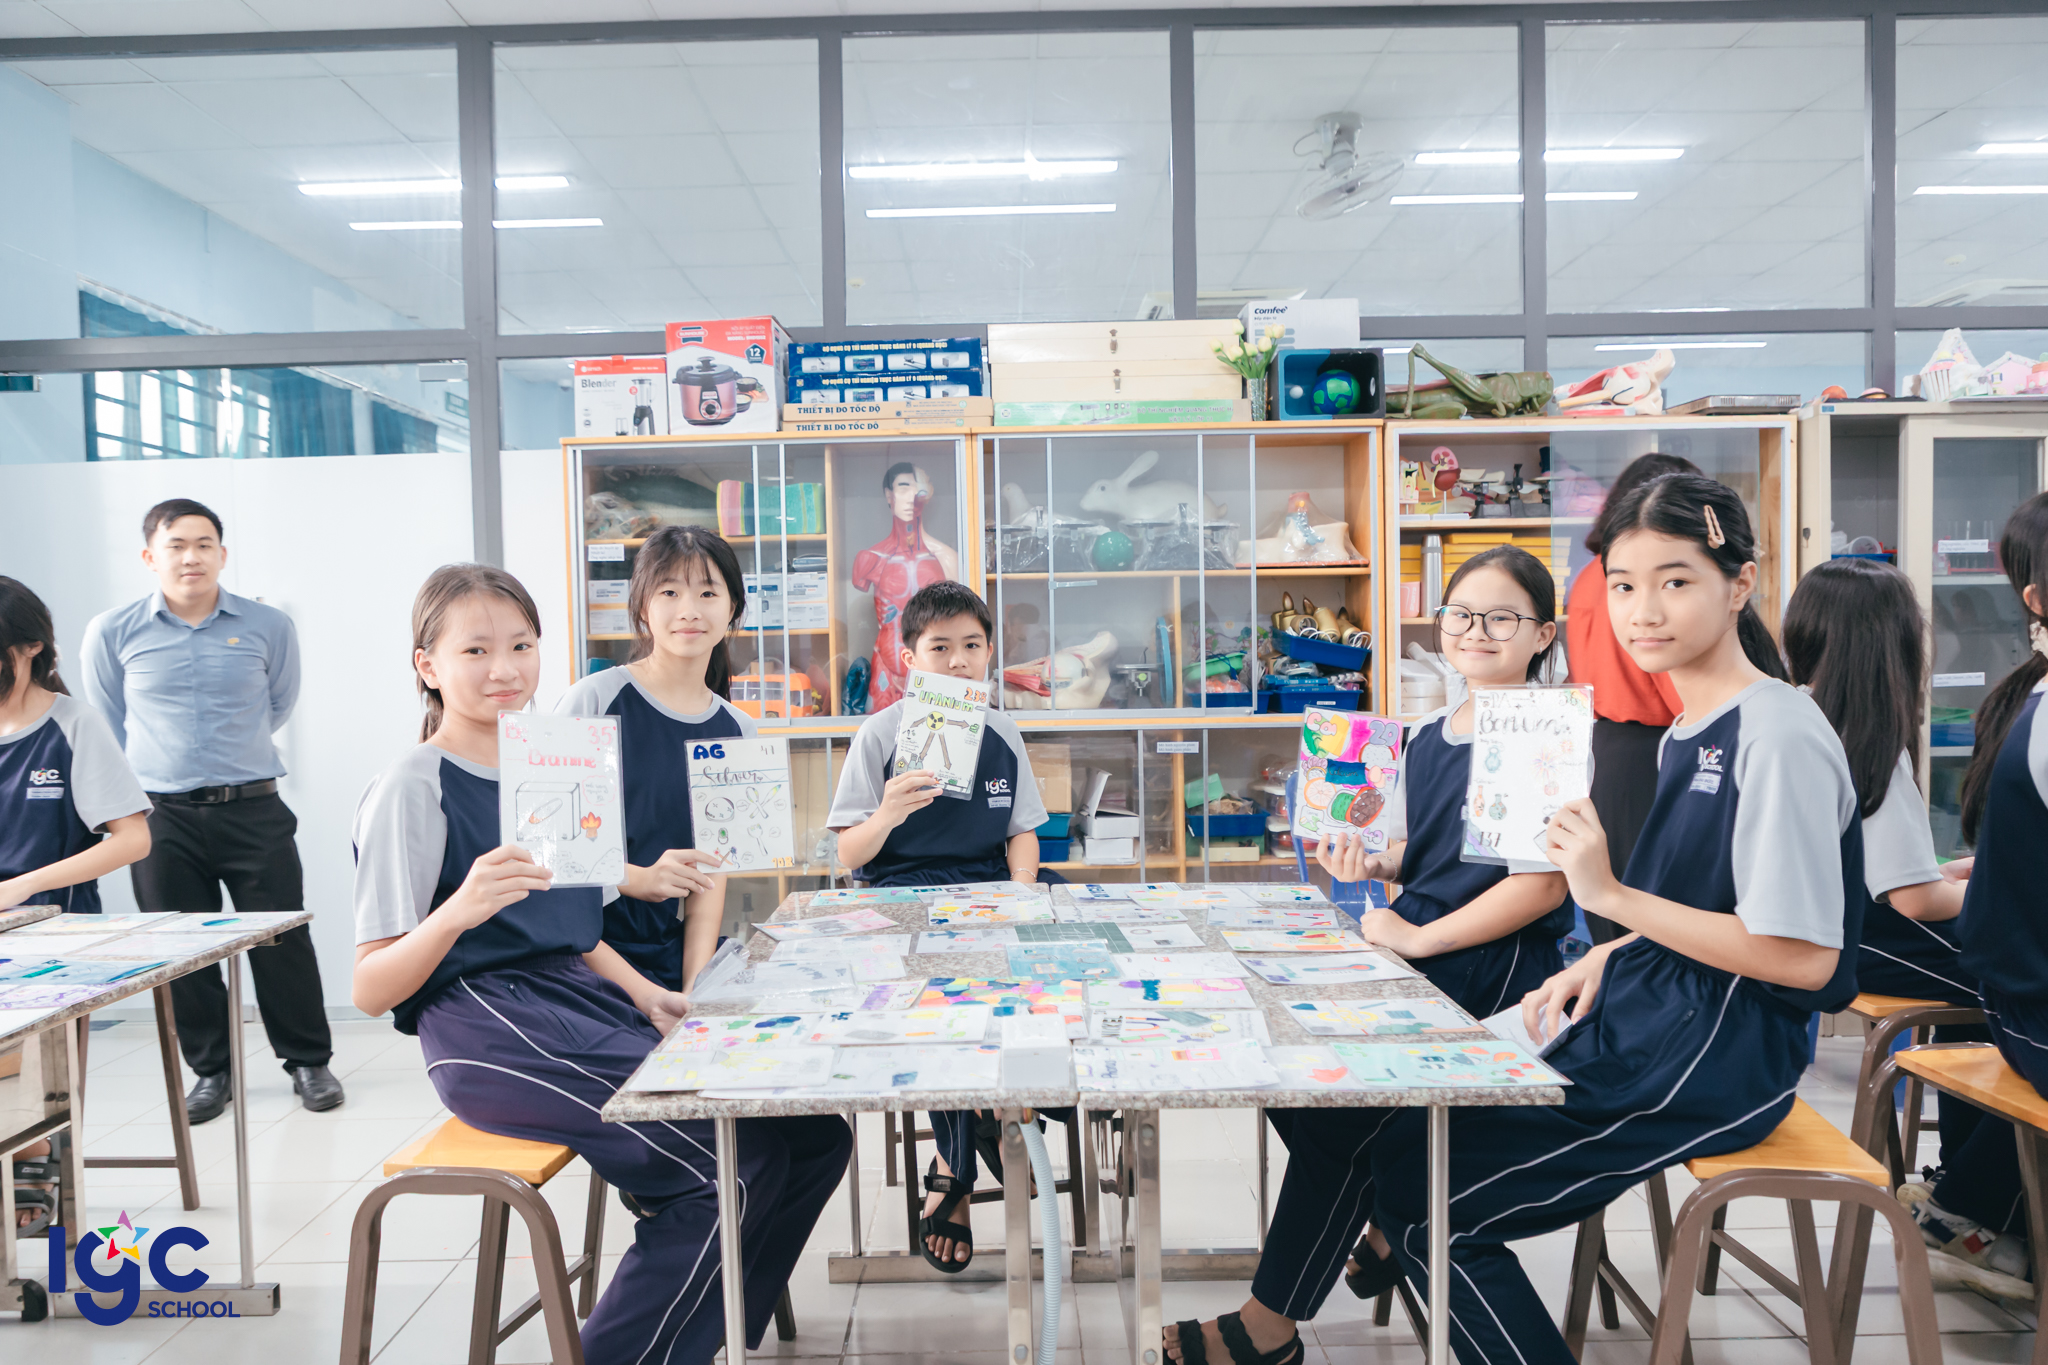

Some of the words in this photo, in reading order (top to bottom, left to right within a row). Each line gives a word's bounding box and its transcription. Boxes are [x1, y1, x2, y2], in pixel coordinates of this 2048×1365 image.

[749, 348, 761, 357] 12
[581, 379, 617, 388] Blender
[798, 404, 823, 414] THIẾT
[914, 676, 924, 688] U
[964, 686, 987, 704] 238
[1306, 712, 1337, 736] Ca
[588, 725, 613, 745] 35
[1369, 720, 1399, 747] 20
[693, 744, 725, 760] AG
[703, 766, 757, 790] Silver
[1362, 827, 1384, 845] 40
[1480, 831, 1501, 847] 137
